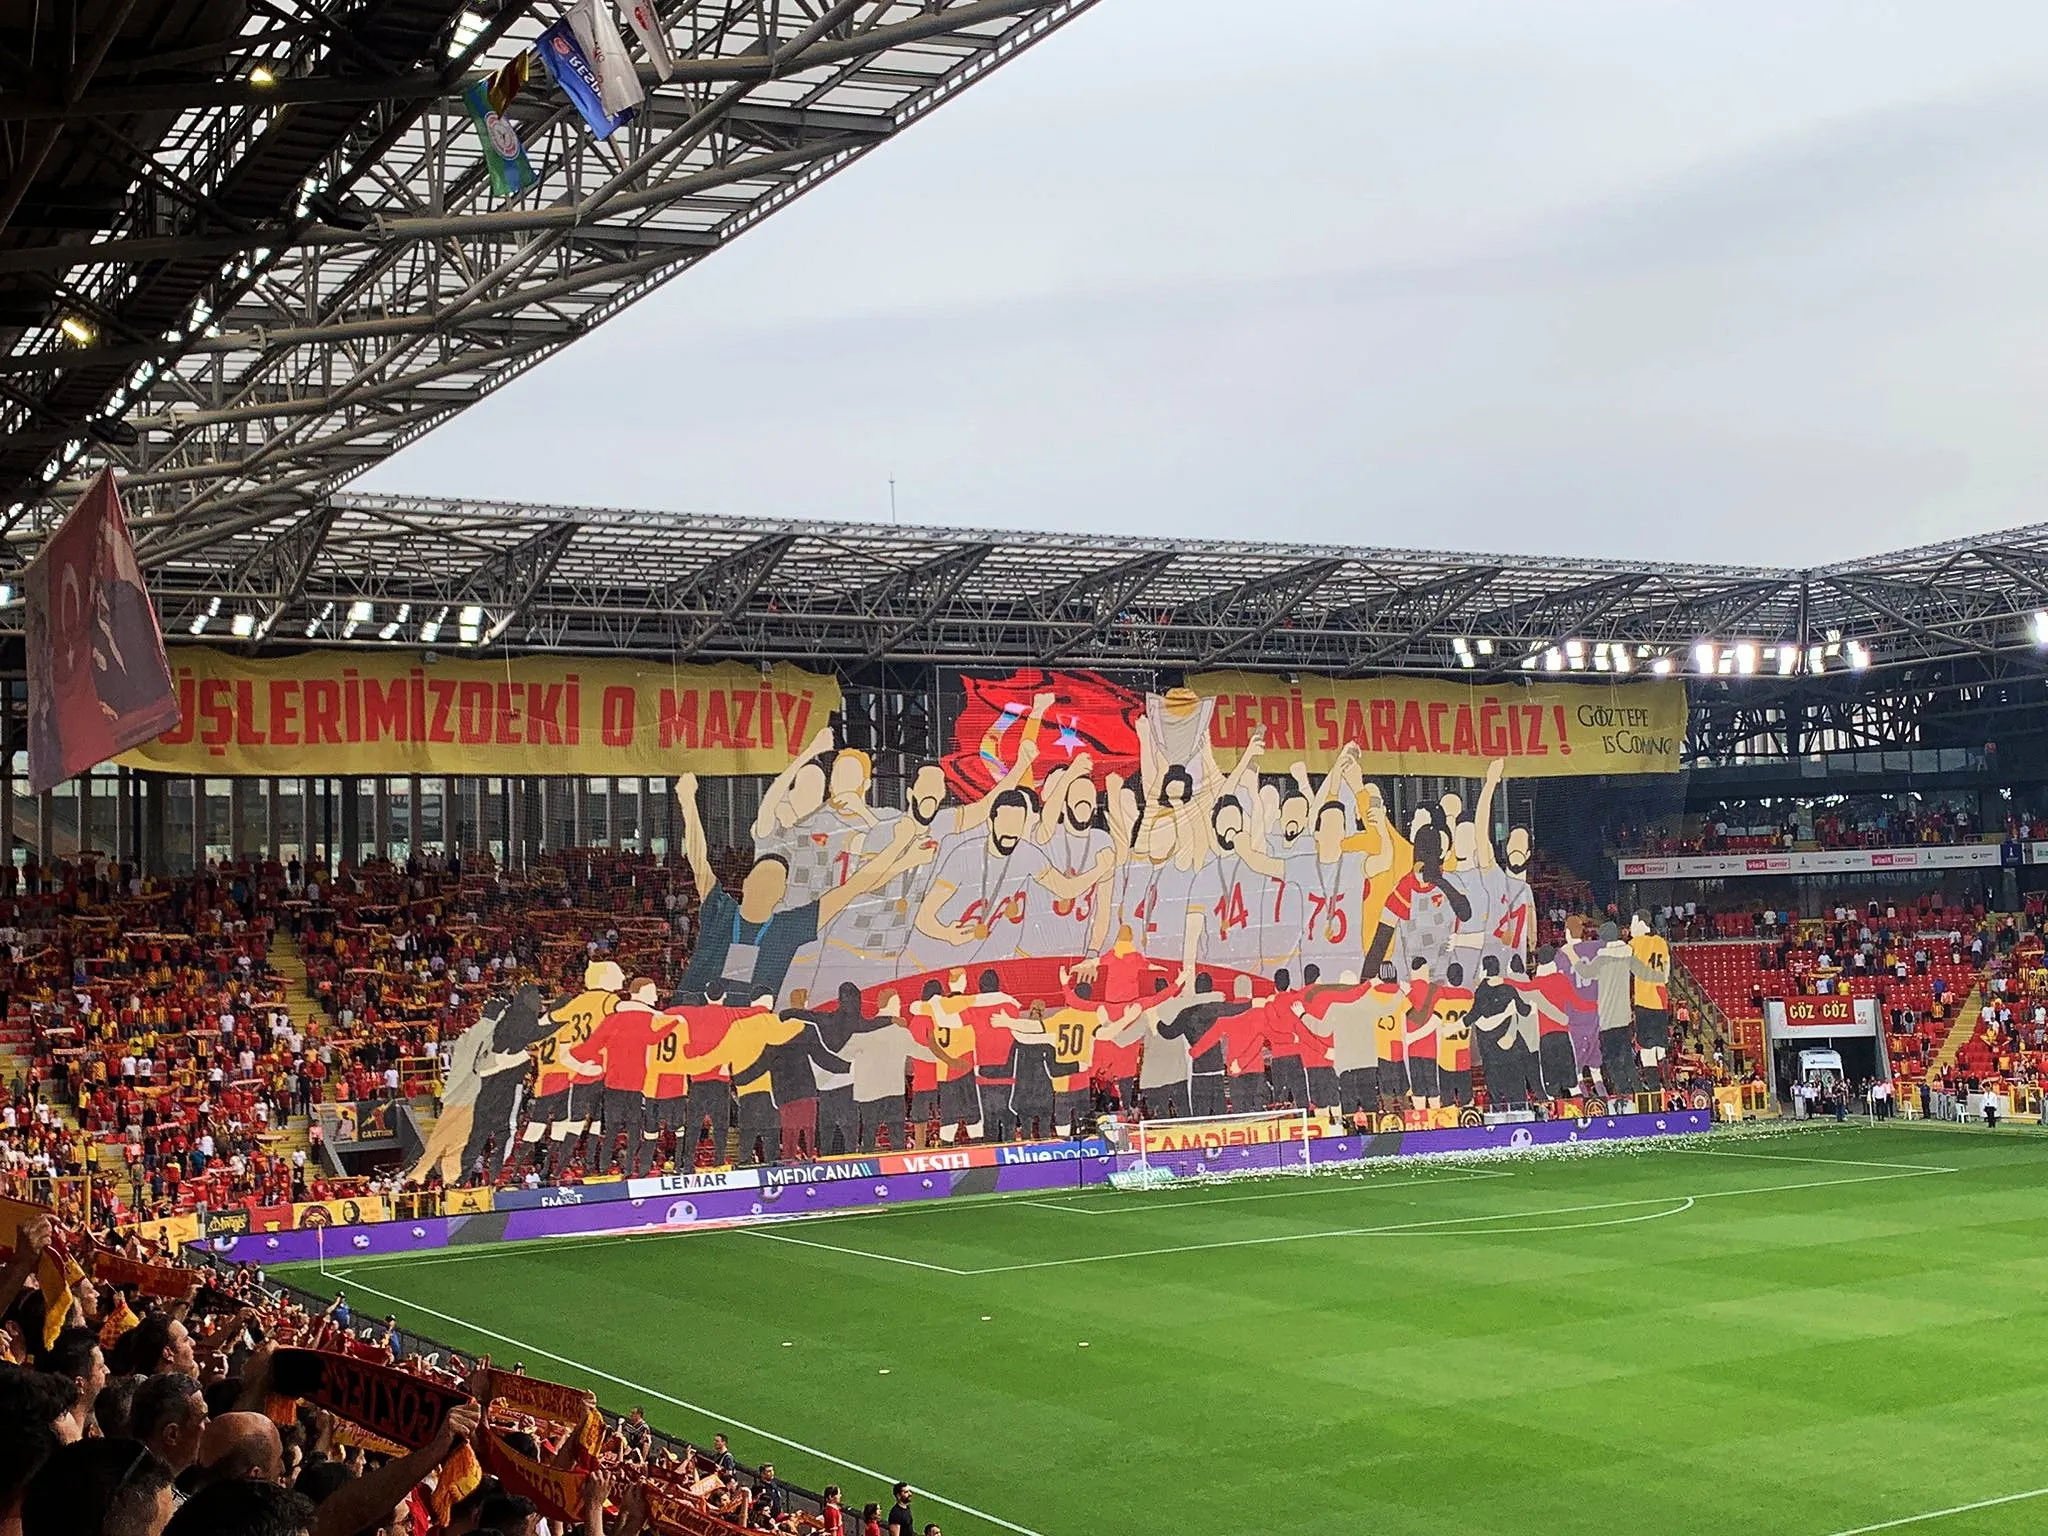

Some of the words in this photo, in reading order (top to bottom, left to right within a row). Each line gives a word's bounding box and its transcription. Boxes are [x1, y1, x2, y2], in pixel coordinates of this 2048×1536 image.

[601, 685, 636, 747] O
[1209, 687, 1306, 750] GERİ
[1822, 1000, 1848, 1018] GÖZ
[1057, 1023, 1085, 1057] 50
[766, 1161, 864, 1186] MEDICANA
